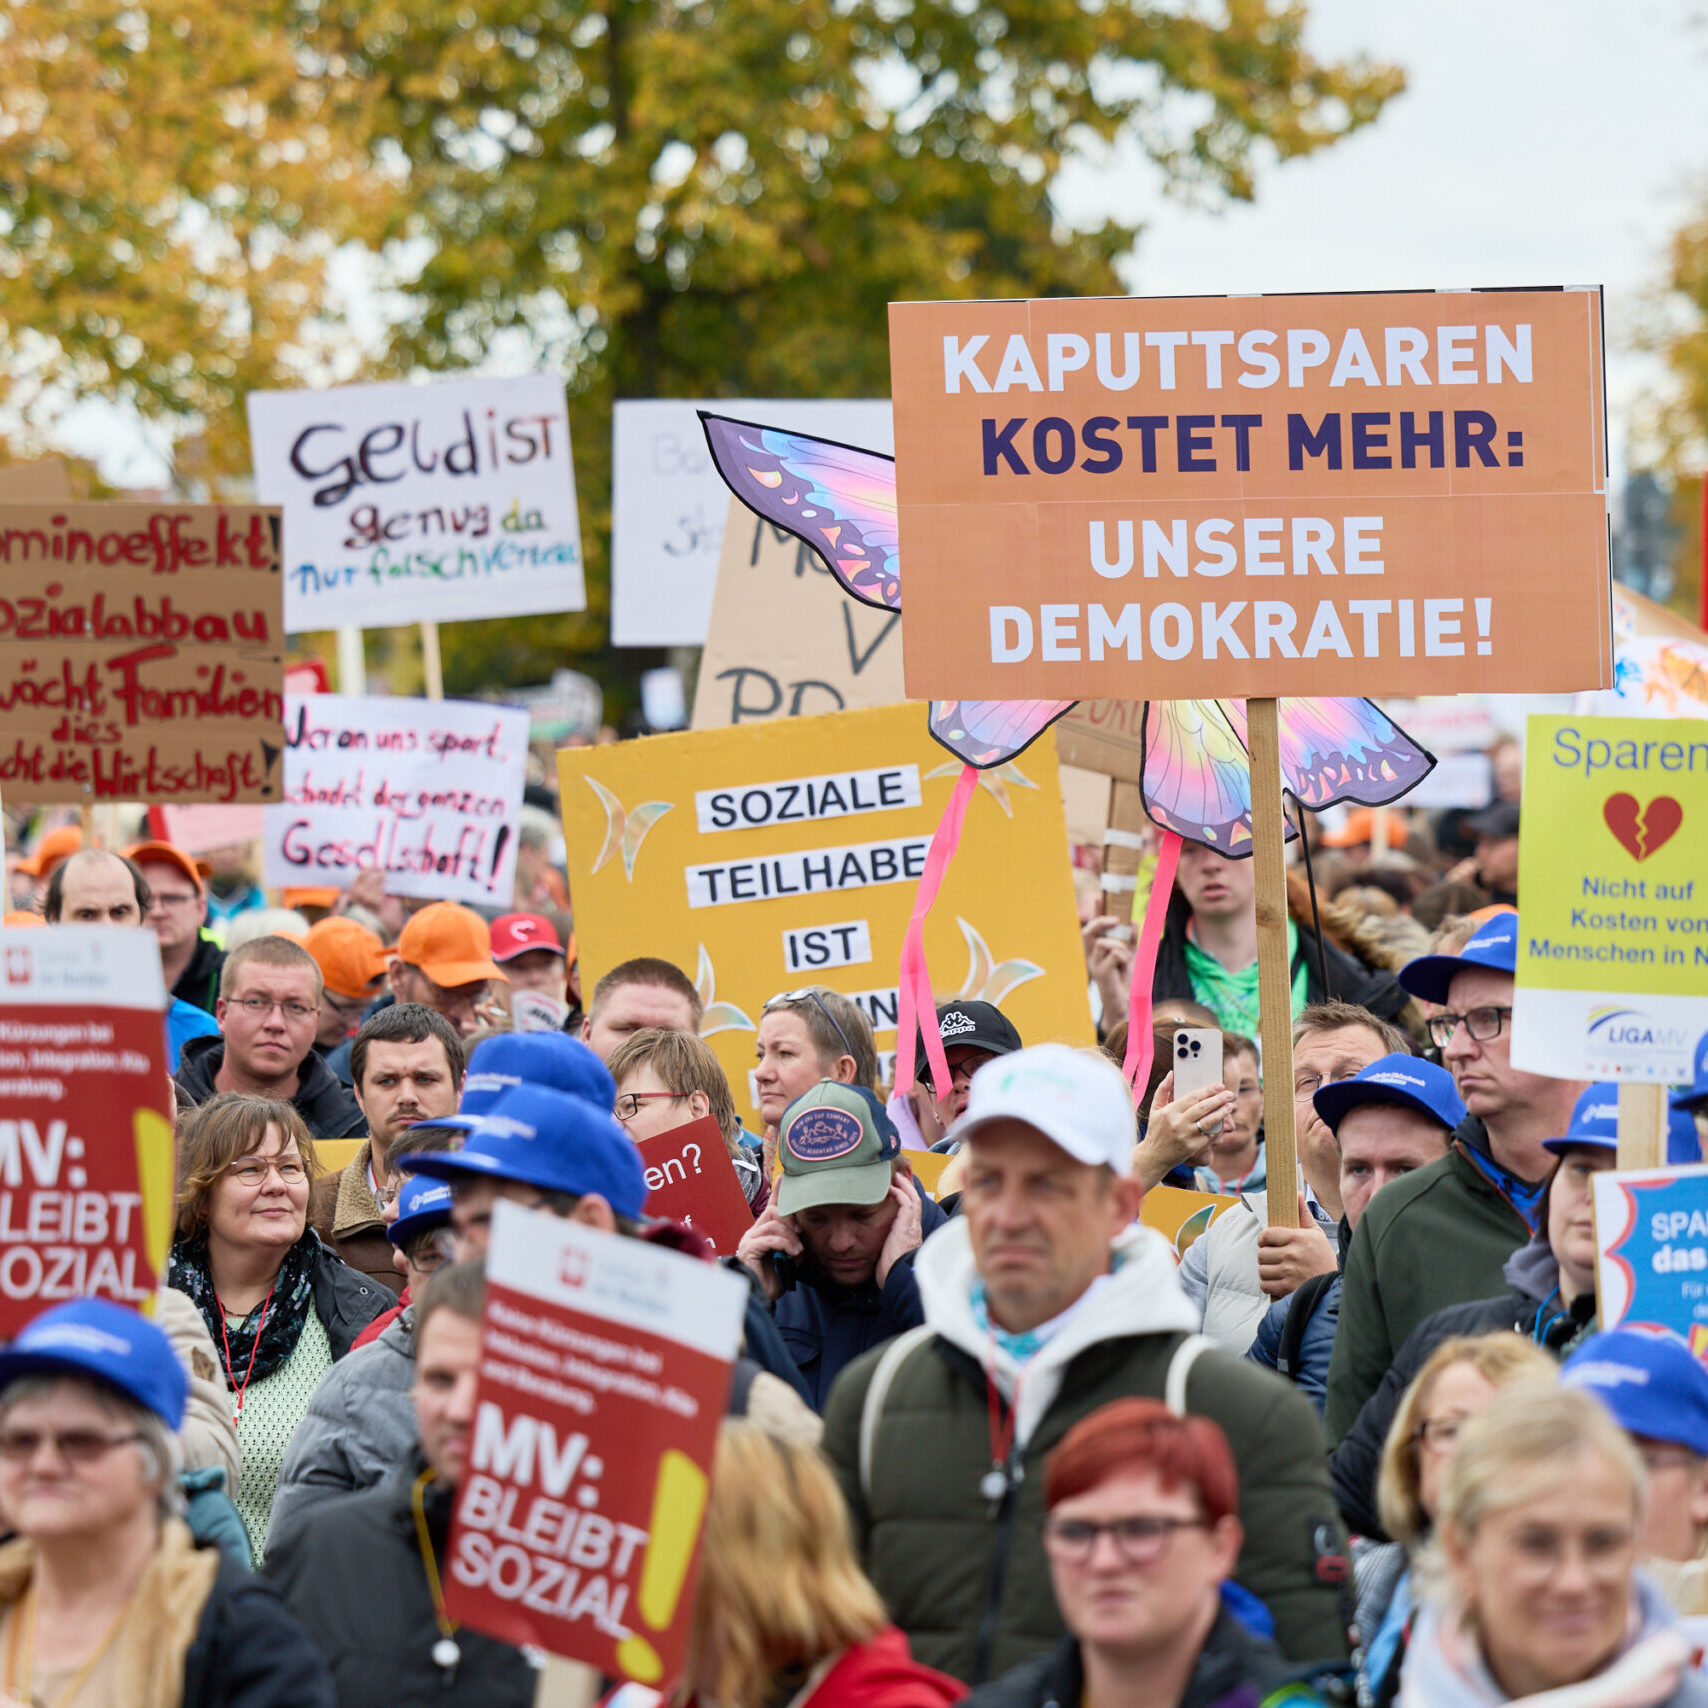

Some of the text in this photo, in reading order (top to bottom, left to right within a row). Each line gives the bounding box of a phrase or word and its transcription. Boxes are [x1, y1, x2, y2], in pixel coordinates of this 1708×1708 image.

[943, 324, 1534, 394] KAPUTTSPAREN
[981, 410, 1524, 476] KOSTET MEHR:
[343, 496, 546, 550] genug da
[1088, 515, 1386, 579] UNSERE
[290, 561, 360, 595] nur
[988, 597, 1494, 664] DEMOKRATIE!
[106, 643, 284, 726] Familien
[52, 715, 122, 743] dies
[337, 730, 369, 748] an
[376, 731, 417, 751] uns
[710, 772, 906, 828] SOZIALE
[697, 843, 927, 903] TEILHABE
[1581, 877, 1695, 900] Nicht auf
[789, 926, 858, 968] IST
[1571, 908, 1657, 931] Kosten
[1528, 938, 1655, 963] Menschen
[1664, 944, 1685, 963] in
[470, 1399, 604, 1509] MV:
[457, 1473, 650, 1578] BLEIBT
[450, 1531, 635, 1641] SOZIAL
